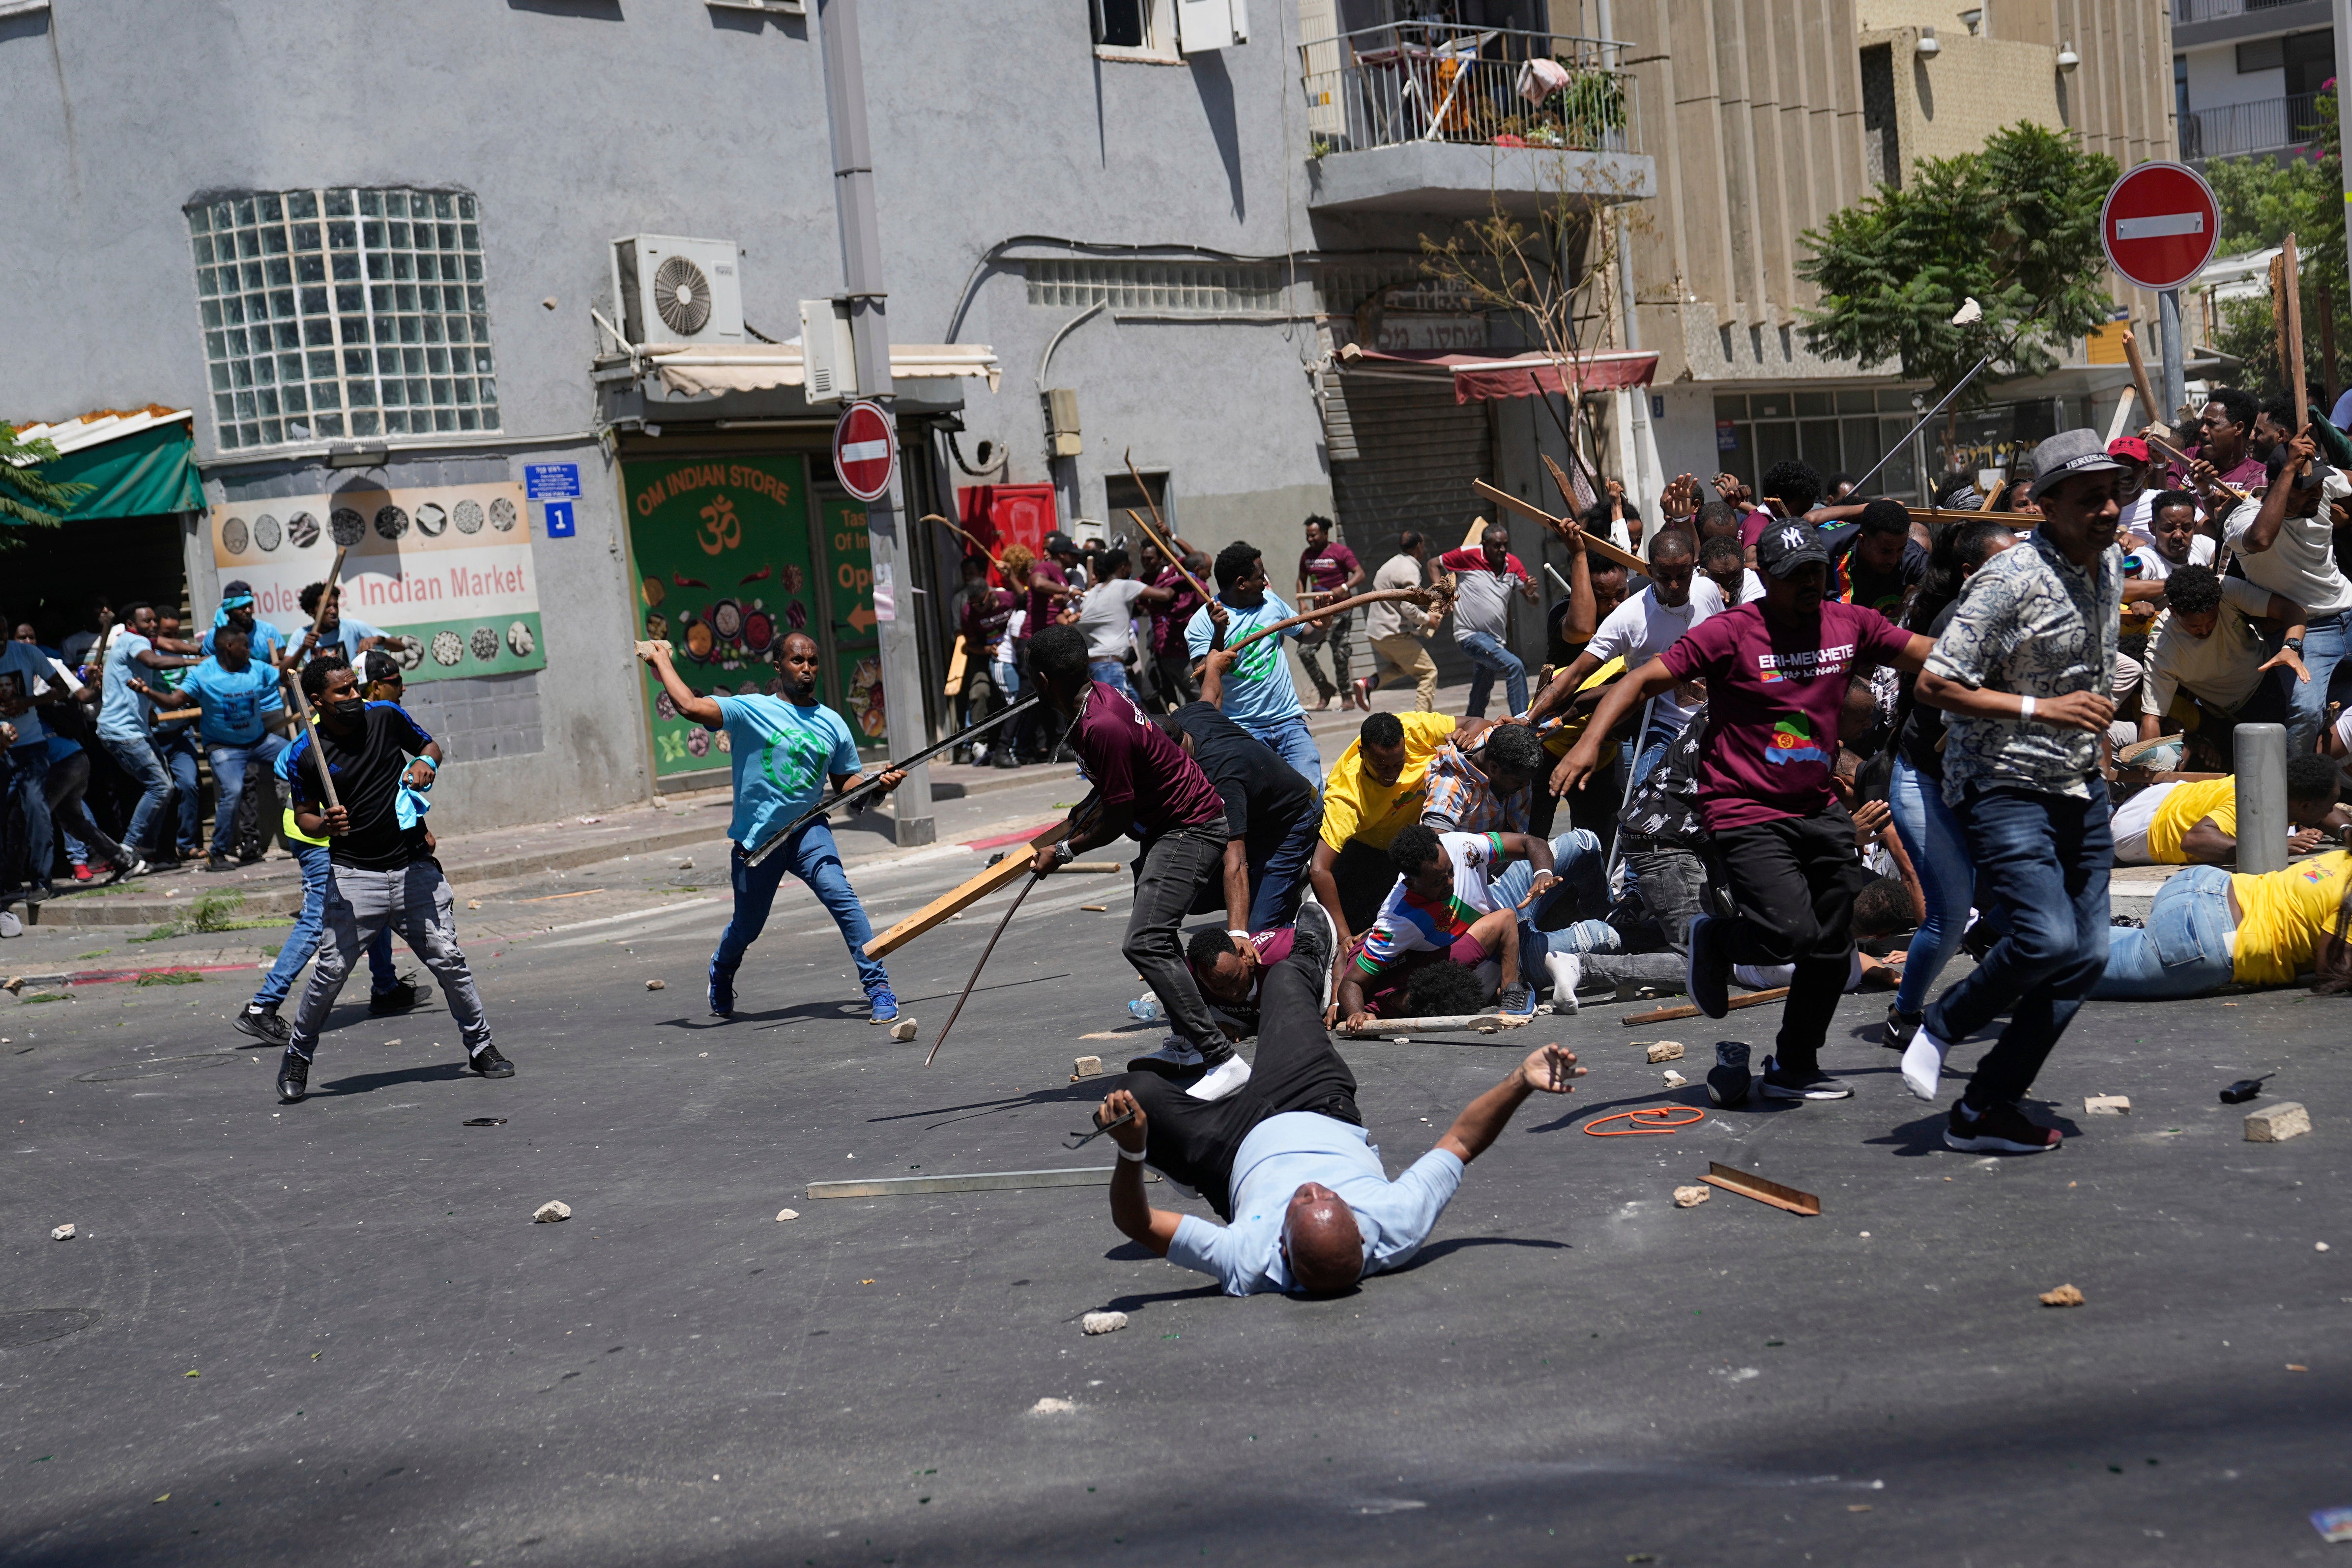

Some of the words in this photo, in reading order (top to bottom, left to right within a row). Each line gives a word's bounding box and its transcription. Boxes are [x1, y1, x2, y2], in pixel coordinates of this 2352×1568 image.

[1655, 398, 1661, 415] 3
[637, 480, 667, 516] OM
[666, 465, 726, 496] INDIAN
[730, 465, 789, 506] STORE
[554, 510, 566, 529] 1
[841, 509, 867, 527] Tas
[835, 532, 852, 551] Of
[856, 533, 869, 549] In
[359, 572, 442, 606] Indian
[450, 564, 525, 598] Market
[1758, 644, 1854, 668] ERI-MEKHETE
